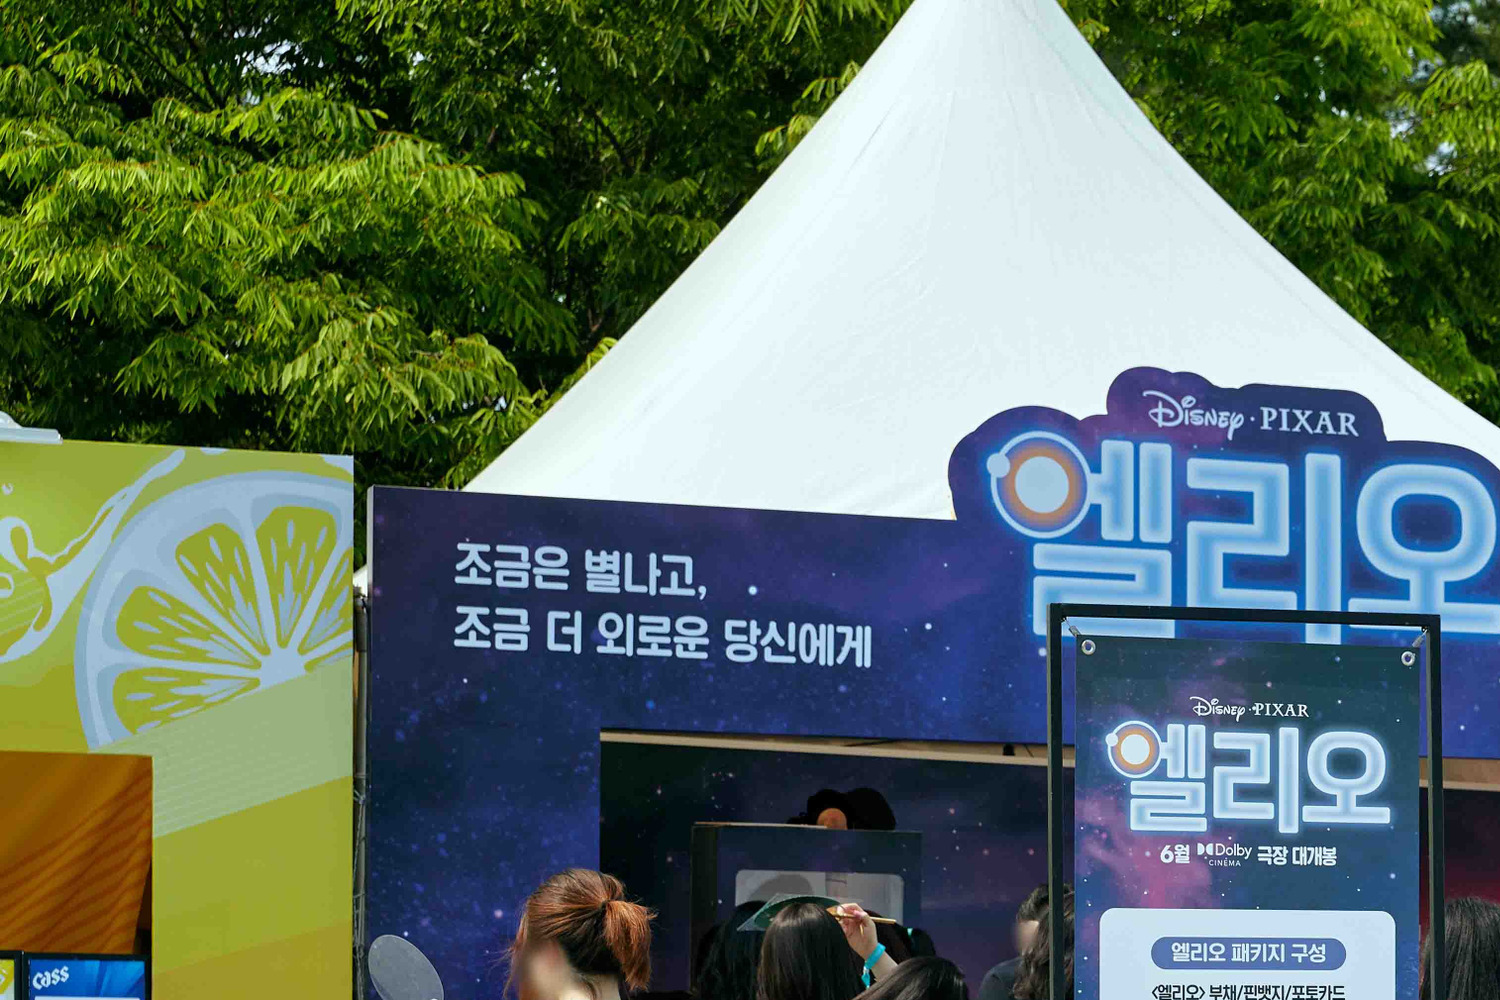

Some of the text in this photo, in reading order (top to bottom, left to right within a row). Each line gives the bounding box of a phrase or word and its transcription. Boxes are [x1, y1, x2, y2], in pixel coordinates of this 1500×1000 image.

[1142, 390, 1359, 440] Disney PIXAR
[454, 542, 707, 600] 조금은 별나고,
[453, 605, 872, 668] 조금 더 외로운 당신에게
[1189, 696, 1310, 722] Disney PIXAR
[1105, 720, 1391, 834] 엘리오
[1160, 843, 1338, 867] 6월 Dolby 극장 대개봉
[1208, 859, 1241, 867] CINEMA
[1171, 943, 1326, 963] 엘리오 패키지 구성
[32, 965, 70, 991] Cass
